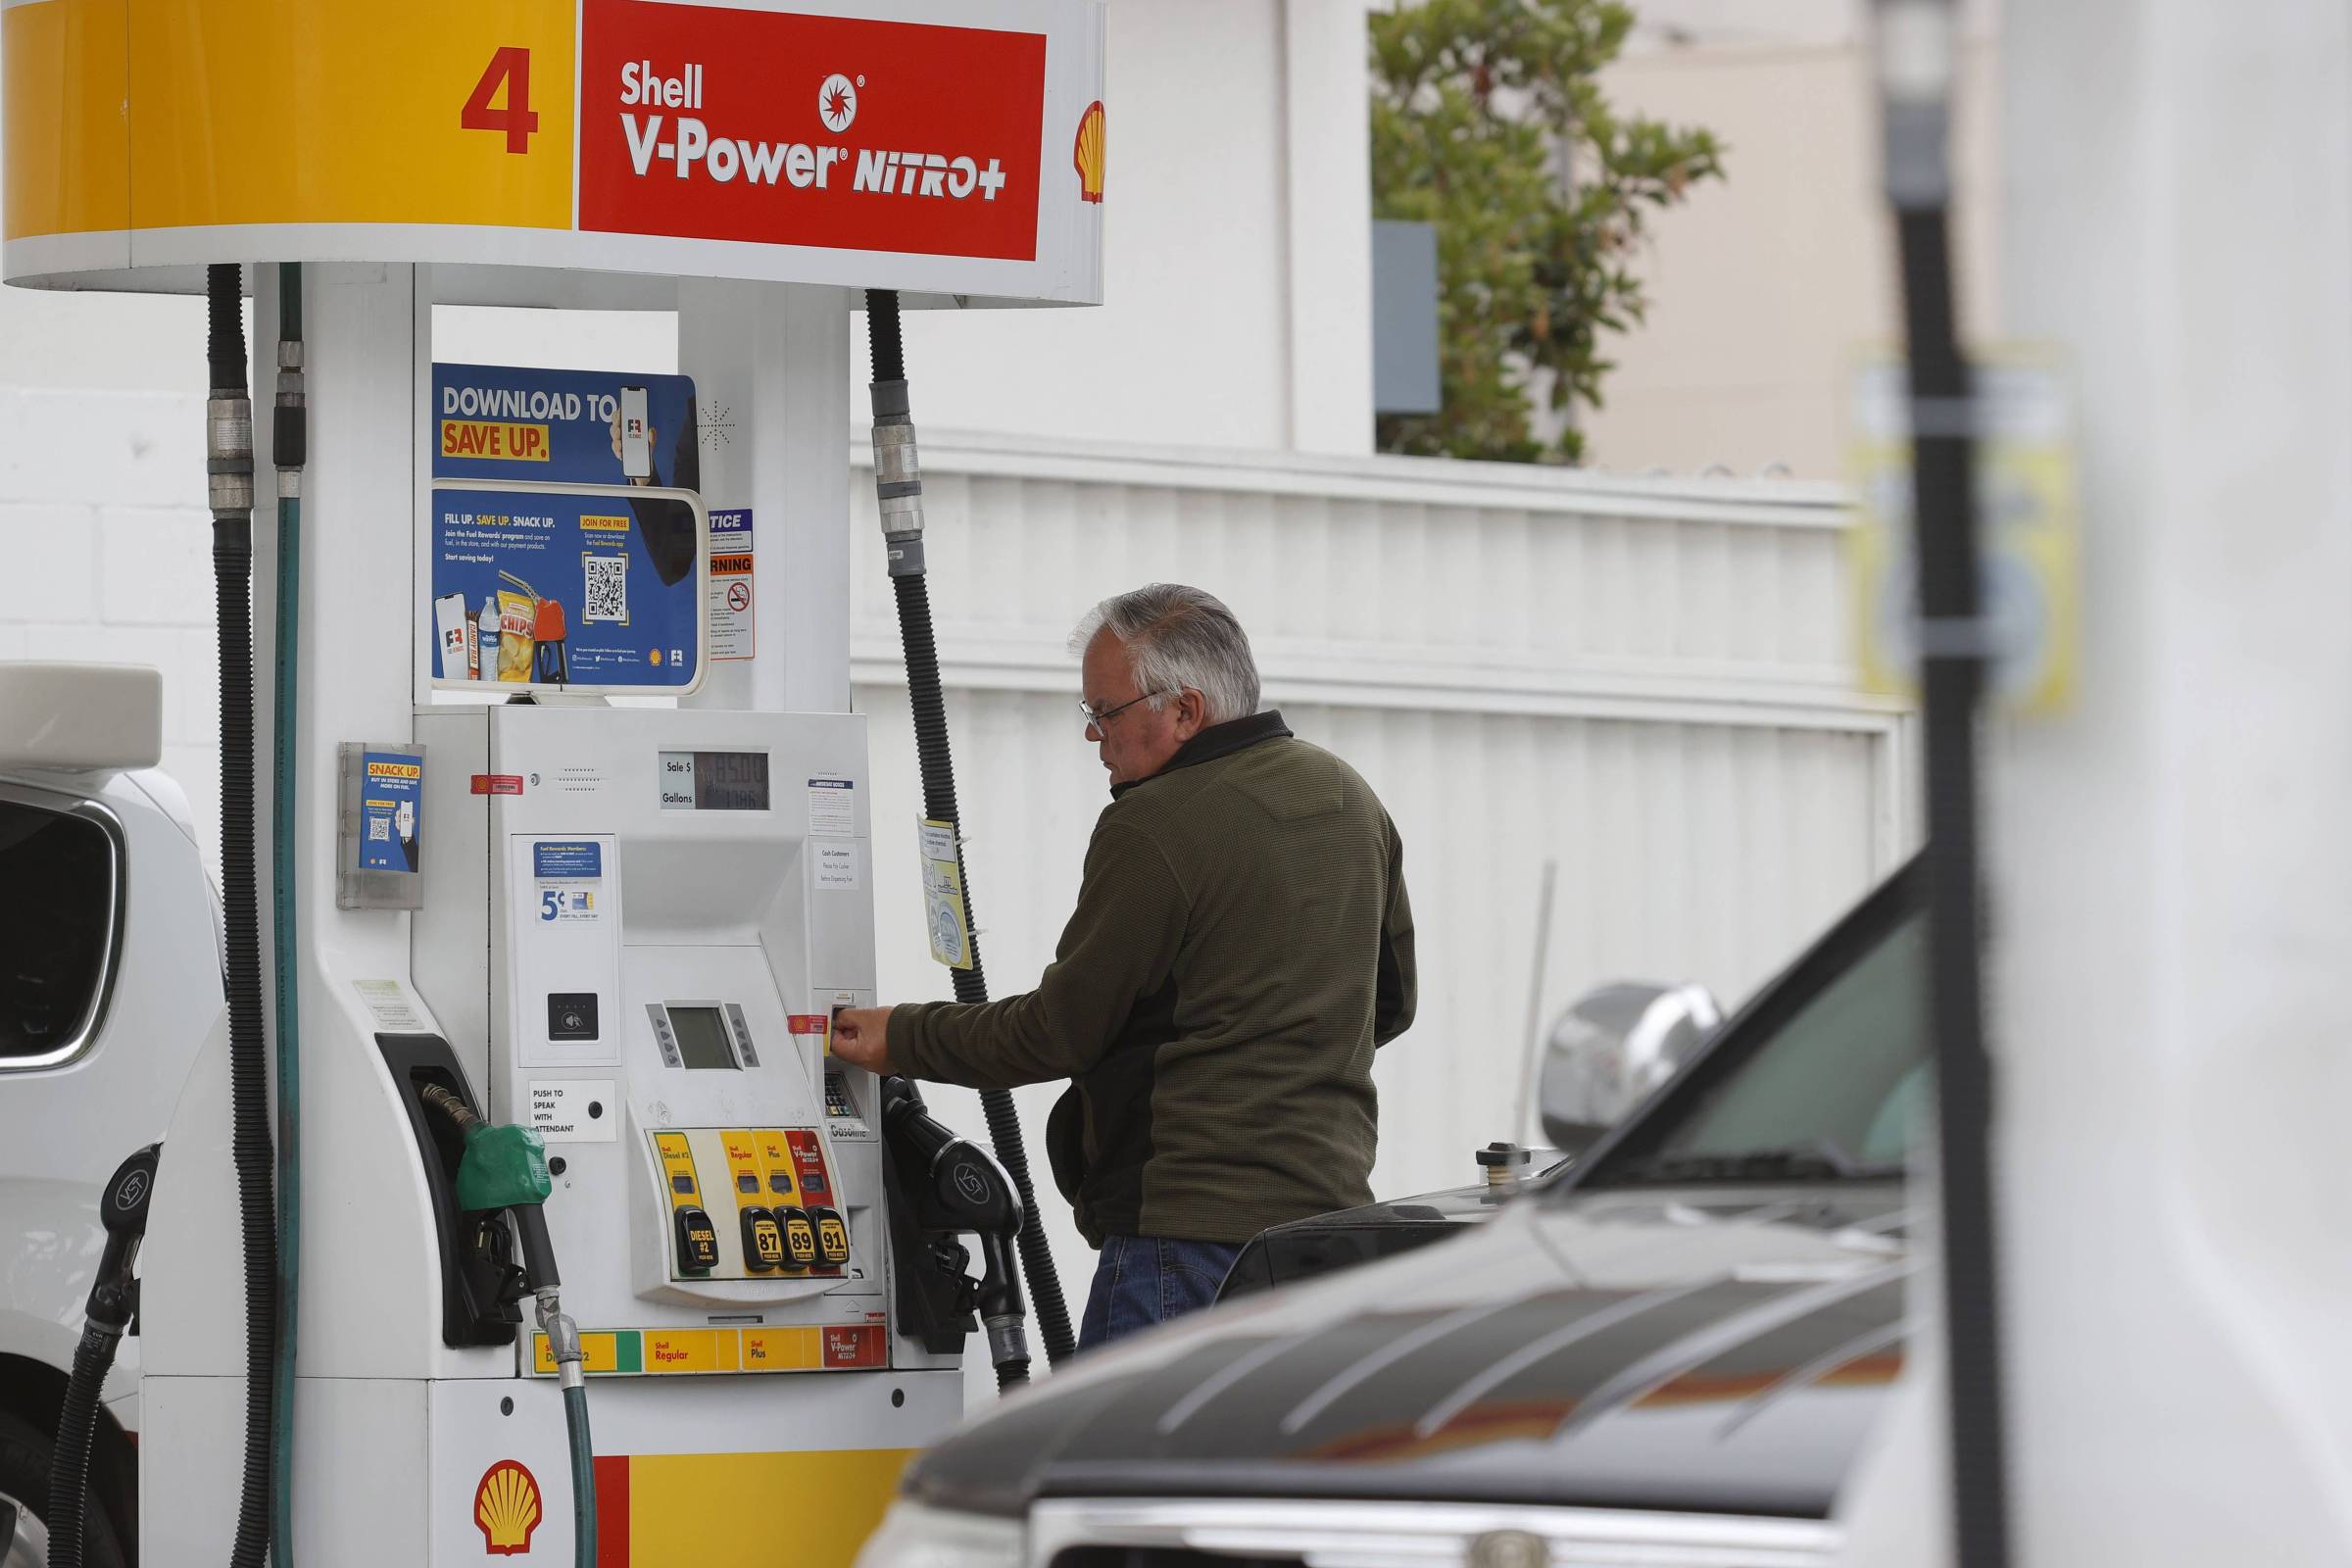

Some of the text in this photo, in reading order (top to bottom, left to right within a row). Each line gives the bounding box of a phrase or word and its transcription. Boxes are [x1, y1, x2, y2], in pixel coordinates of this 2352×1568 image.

[619, 60, 703, 110] Shell
[461, 46, 539, 155] 4
[443, 386, 618, 423] DOWNLOAD TO
[444, 422, 547, 459] SAVE UP.
[444, 513, 556, 528] FILL UP. SAVE UP. SNACK UP.
[582, 518, 627, 528] JOIN FOR FREE
[710, 514, 742, 528] TICE
[459, 554, 476, 564] saving
[476, 554, 494, 564] today!
[710, 558, 752, 572] RNING
[500, 613, 534, 639] CHIPS
[369, 764, 419, 777] SNACK UP.
[666, 761, 691, 773] Sale $
[662, 793, 693, 804] Gallons
[730, 1151, 753, 1160] Regular
[793, 1150, 817, 1158] V-Power
[958, 1167, 983, 1196] VST
[120, 1176, 143, 1205] VST
[690, 1229, 714, 1242] DIESEL
[759, 1233, 777, 1251] 87
[791, 1232, 811, 1250] 89
[823, 1231, 845, 1250] 91
[699, 1242, 710, 1252] #2
[751, 1348, 766, 1358] Plus
[830, 1342, 856, 1351] V-Power
[655, 1349, 689, 1362] Regular
